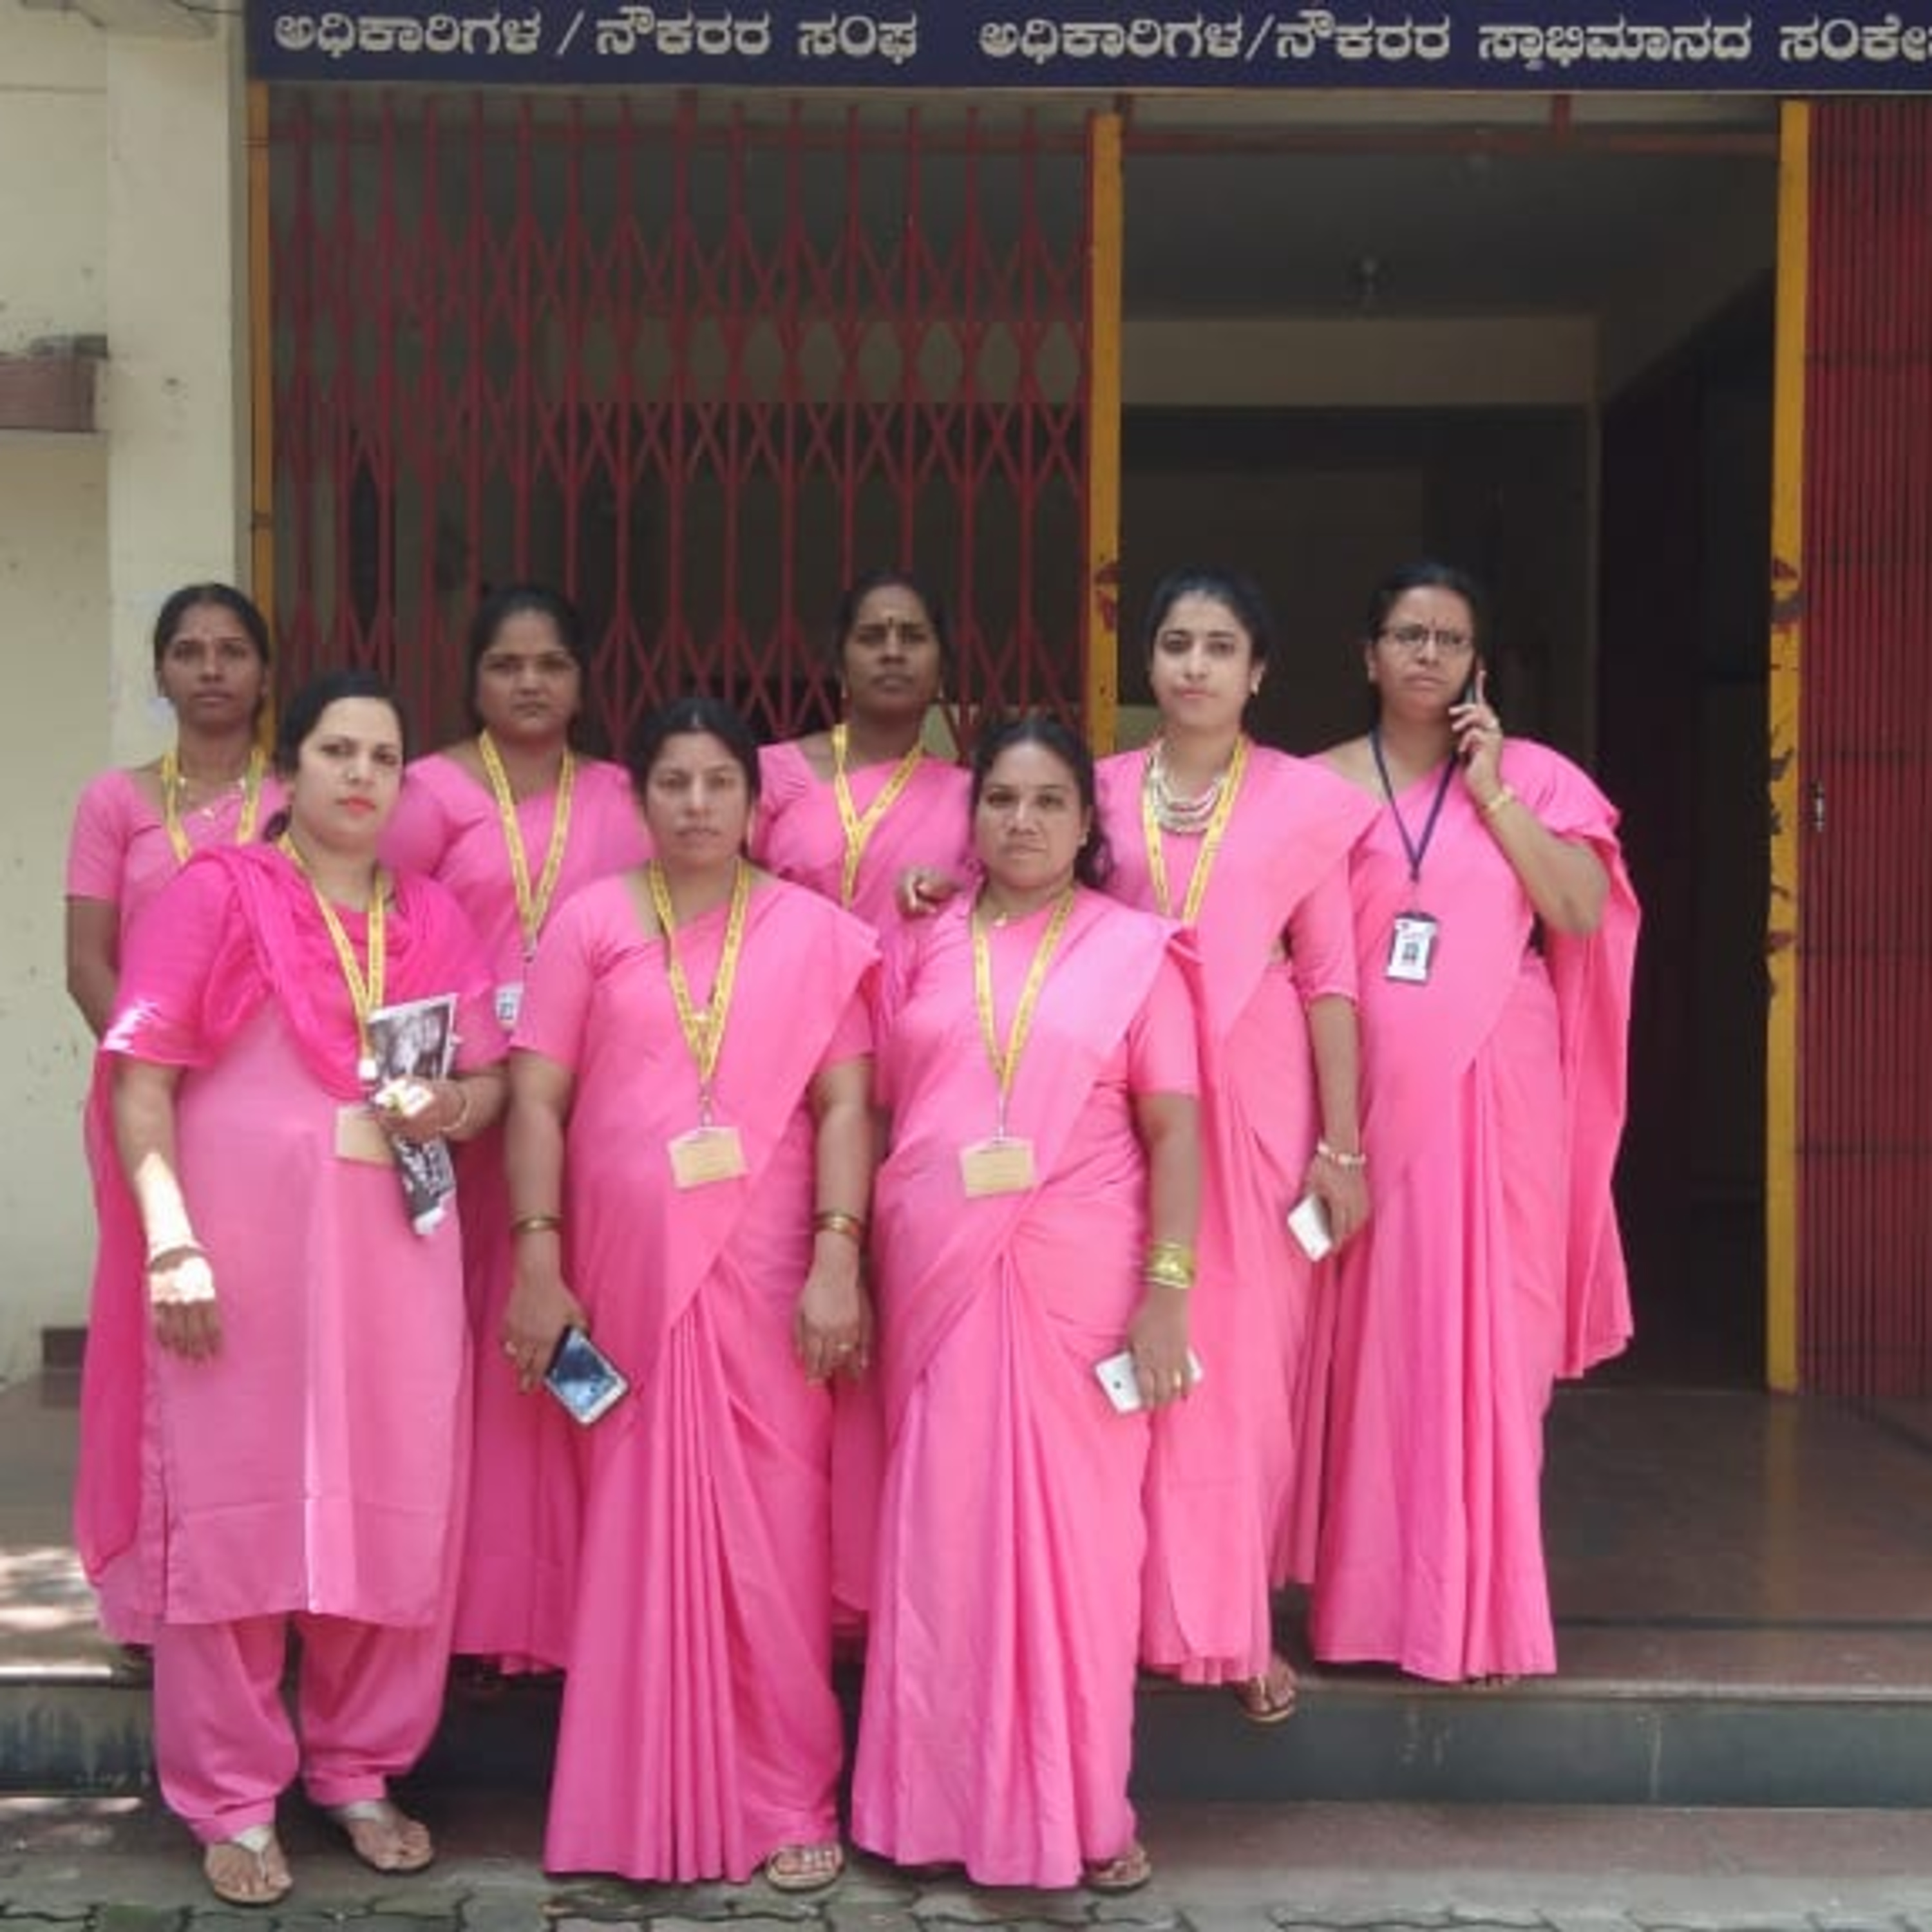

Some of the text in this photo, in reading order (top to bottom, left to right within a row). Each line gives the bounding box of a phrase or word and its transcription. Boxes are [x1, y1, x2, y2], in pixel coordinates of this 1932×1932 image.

[274, 11, 541, 58] ಅಧಿಕಾರಿಗಳ
[596, 5, 771, 55] ನೌಕರರ
[799, 13, 917, 64] ಸಂಘ
[1779, 14, 1932, 62] ಸಂಕೇ
